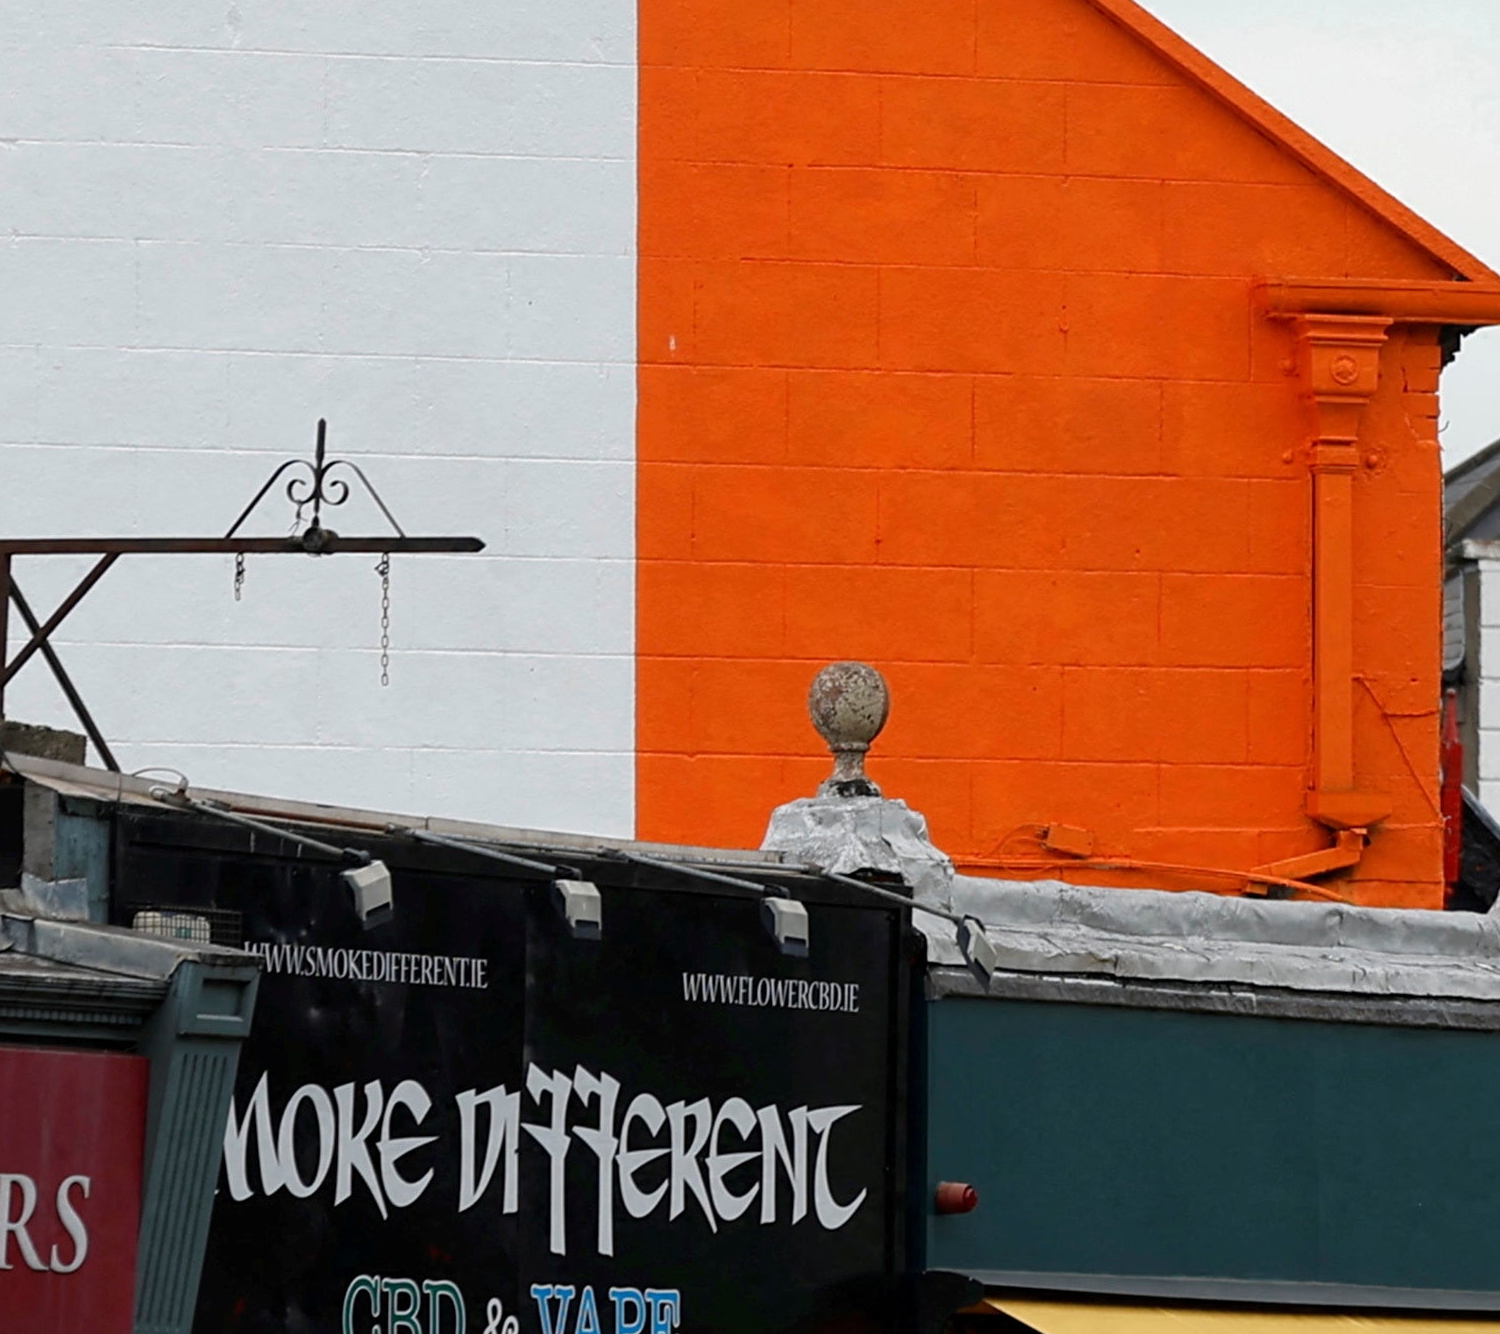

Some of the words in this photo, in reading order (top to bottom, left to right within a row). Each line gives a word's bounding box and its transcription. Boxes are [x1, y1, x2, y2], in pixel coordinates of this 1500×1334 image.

[682, 971, 860, 1013] WWW.FLOWERCBD.IE
[214, 1070, 440, 1220] MOKE
[456, 1061, 868, 1258] DIFFERENT
